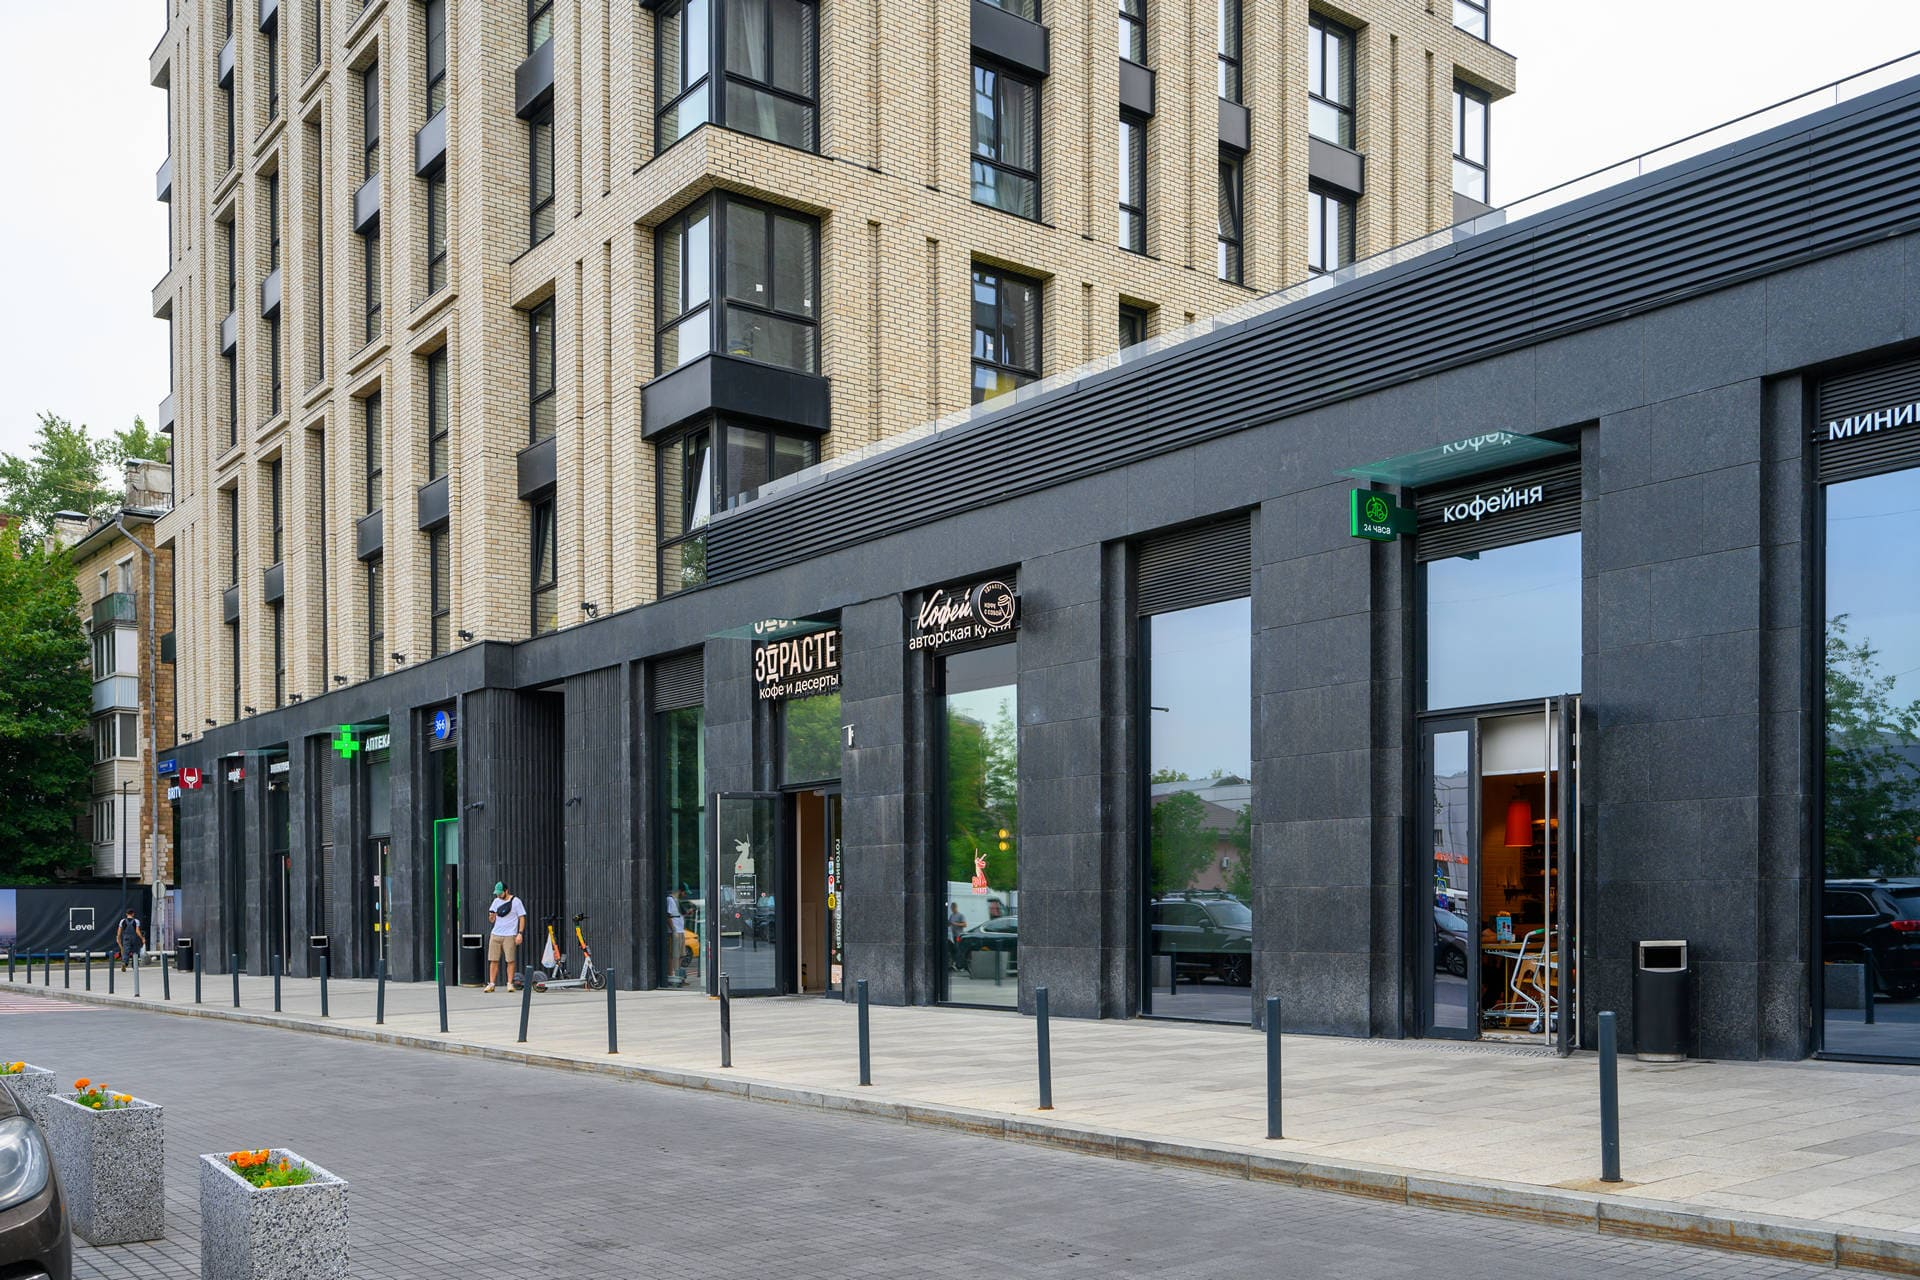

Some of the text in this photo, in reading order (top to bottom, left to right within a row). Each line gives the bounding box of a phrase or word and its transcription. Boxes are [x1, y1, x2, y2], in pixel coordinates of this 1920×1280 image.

[1444, 485, 1543, 523] кофейня
[1364, 523, 1391, 535] 24 часа
[917, 588, 973, 631] Кофей
[909, 625, 971, 650] авторская
[755, 630, 837, 685] ЗДРАСТЕ
[760, 673, 839, 700] кофе и десерты
